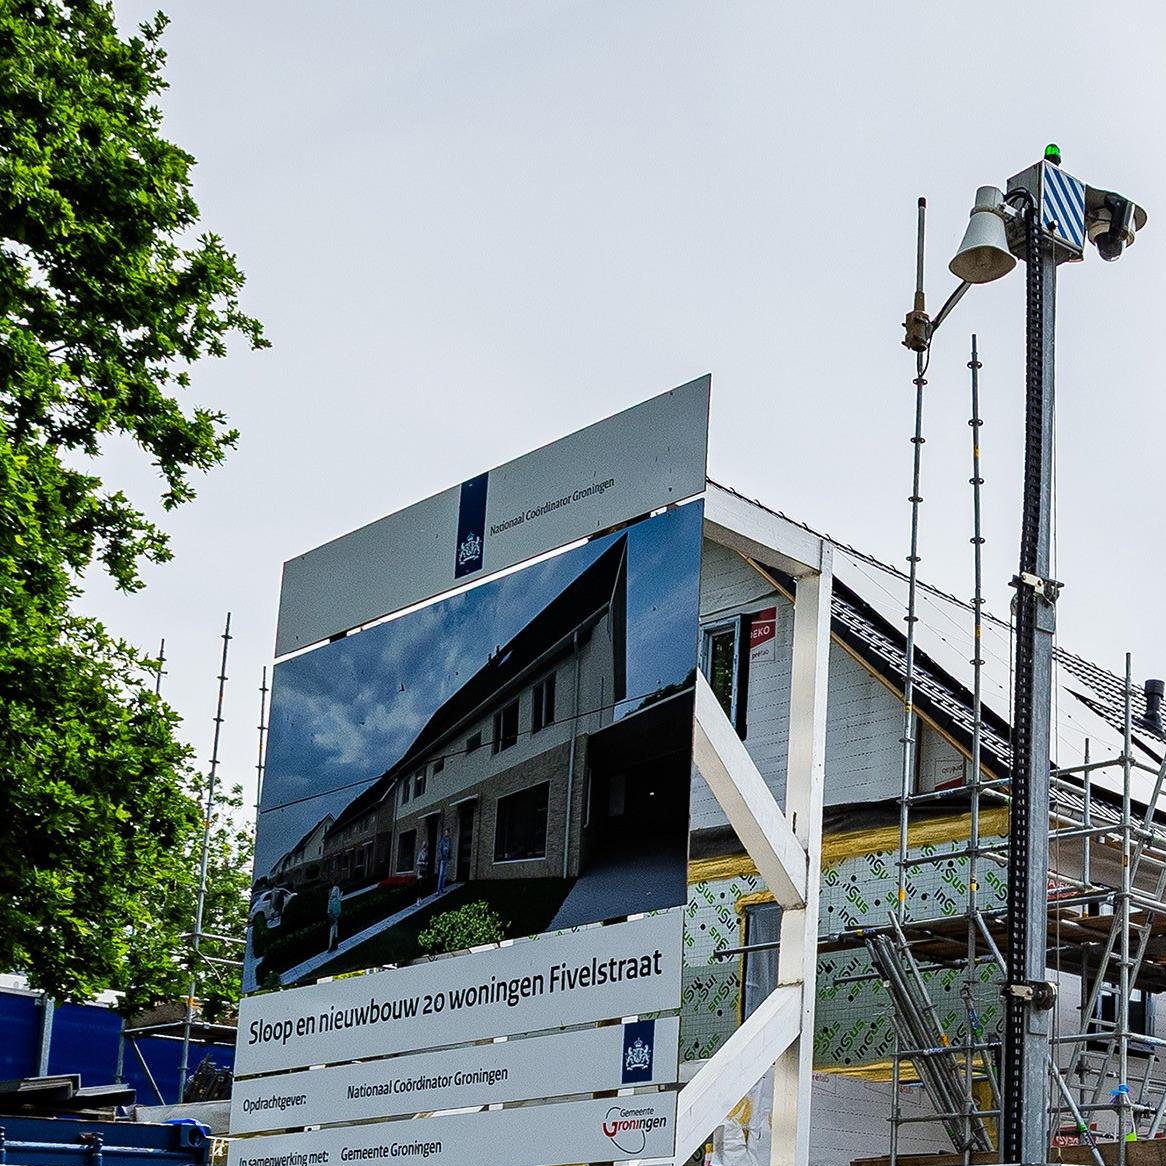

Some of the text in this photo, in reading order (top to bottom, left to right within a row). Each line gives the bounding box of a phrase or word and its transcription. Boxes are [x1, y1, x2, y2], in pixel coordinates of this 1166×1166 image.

[490, 512, 525, 536] Nationaal
[572, 478, 615, 503] Groningen
[249, 1019, 293, 1045] Sloop
[296, 1015, 315, 1036] en
[319, 998, 420, 1033] nieuwbouw
[422, 993, 445, 1014] 20
[449, 976, 544, 1007] woningen
[549, 950, 662, 993] Fivelstraat
[243, 1095, 307, 1114] Opdrachtgever:
[347, 1080, 392, 1099] Nationaal
[454, 1068, 508, 1086] Groningen
[602, 1116, 667, 1138] Groningen
[620, 1107, 655, 1118] Gemeente
[309, 1151, 329, 1163] met:
[341, 1144, 388, 1161] Gemeente
[390, 1140, 442, 1157] Groningen
